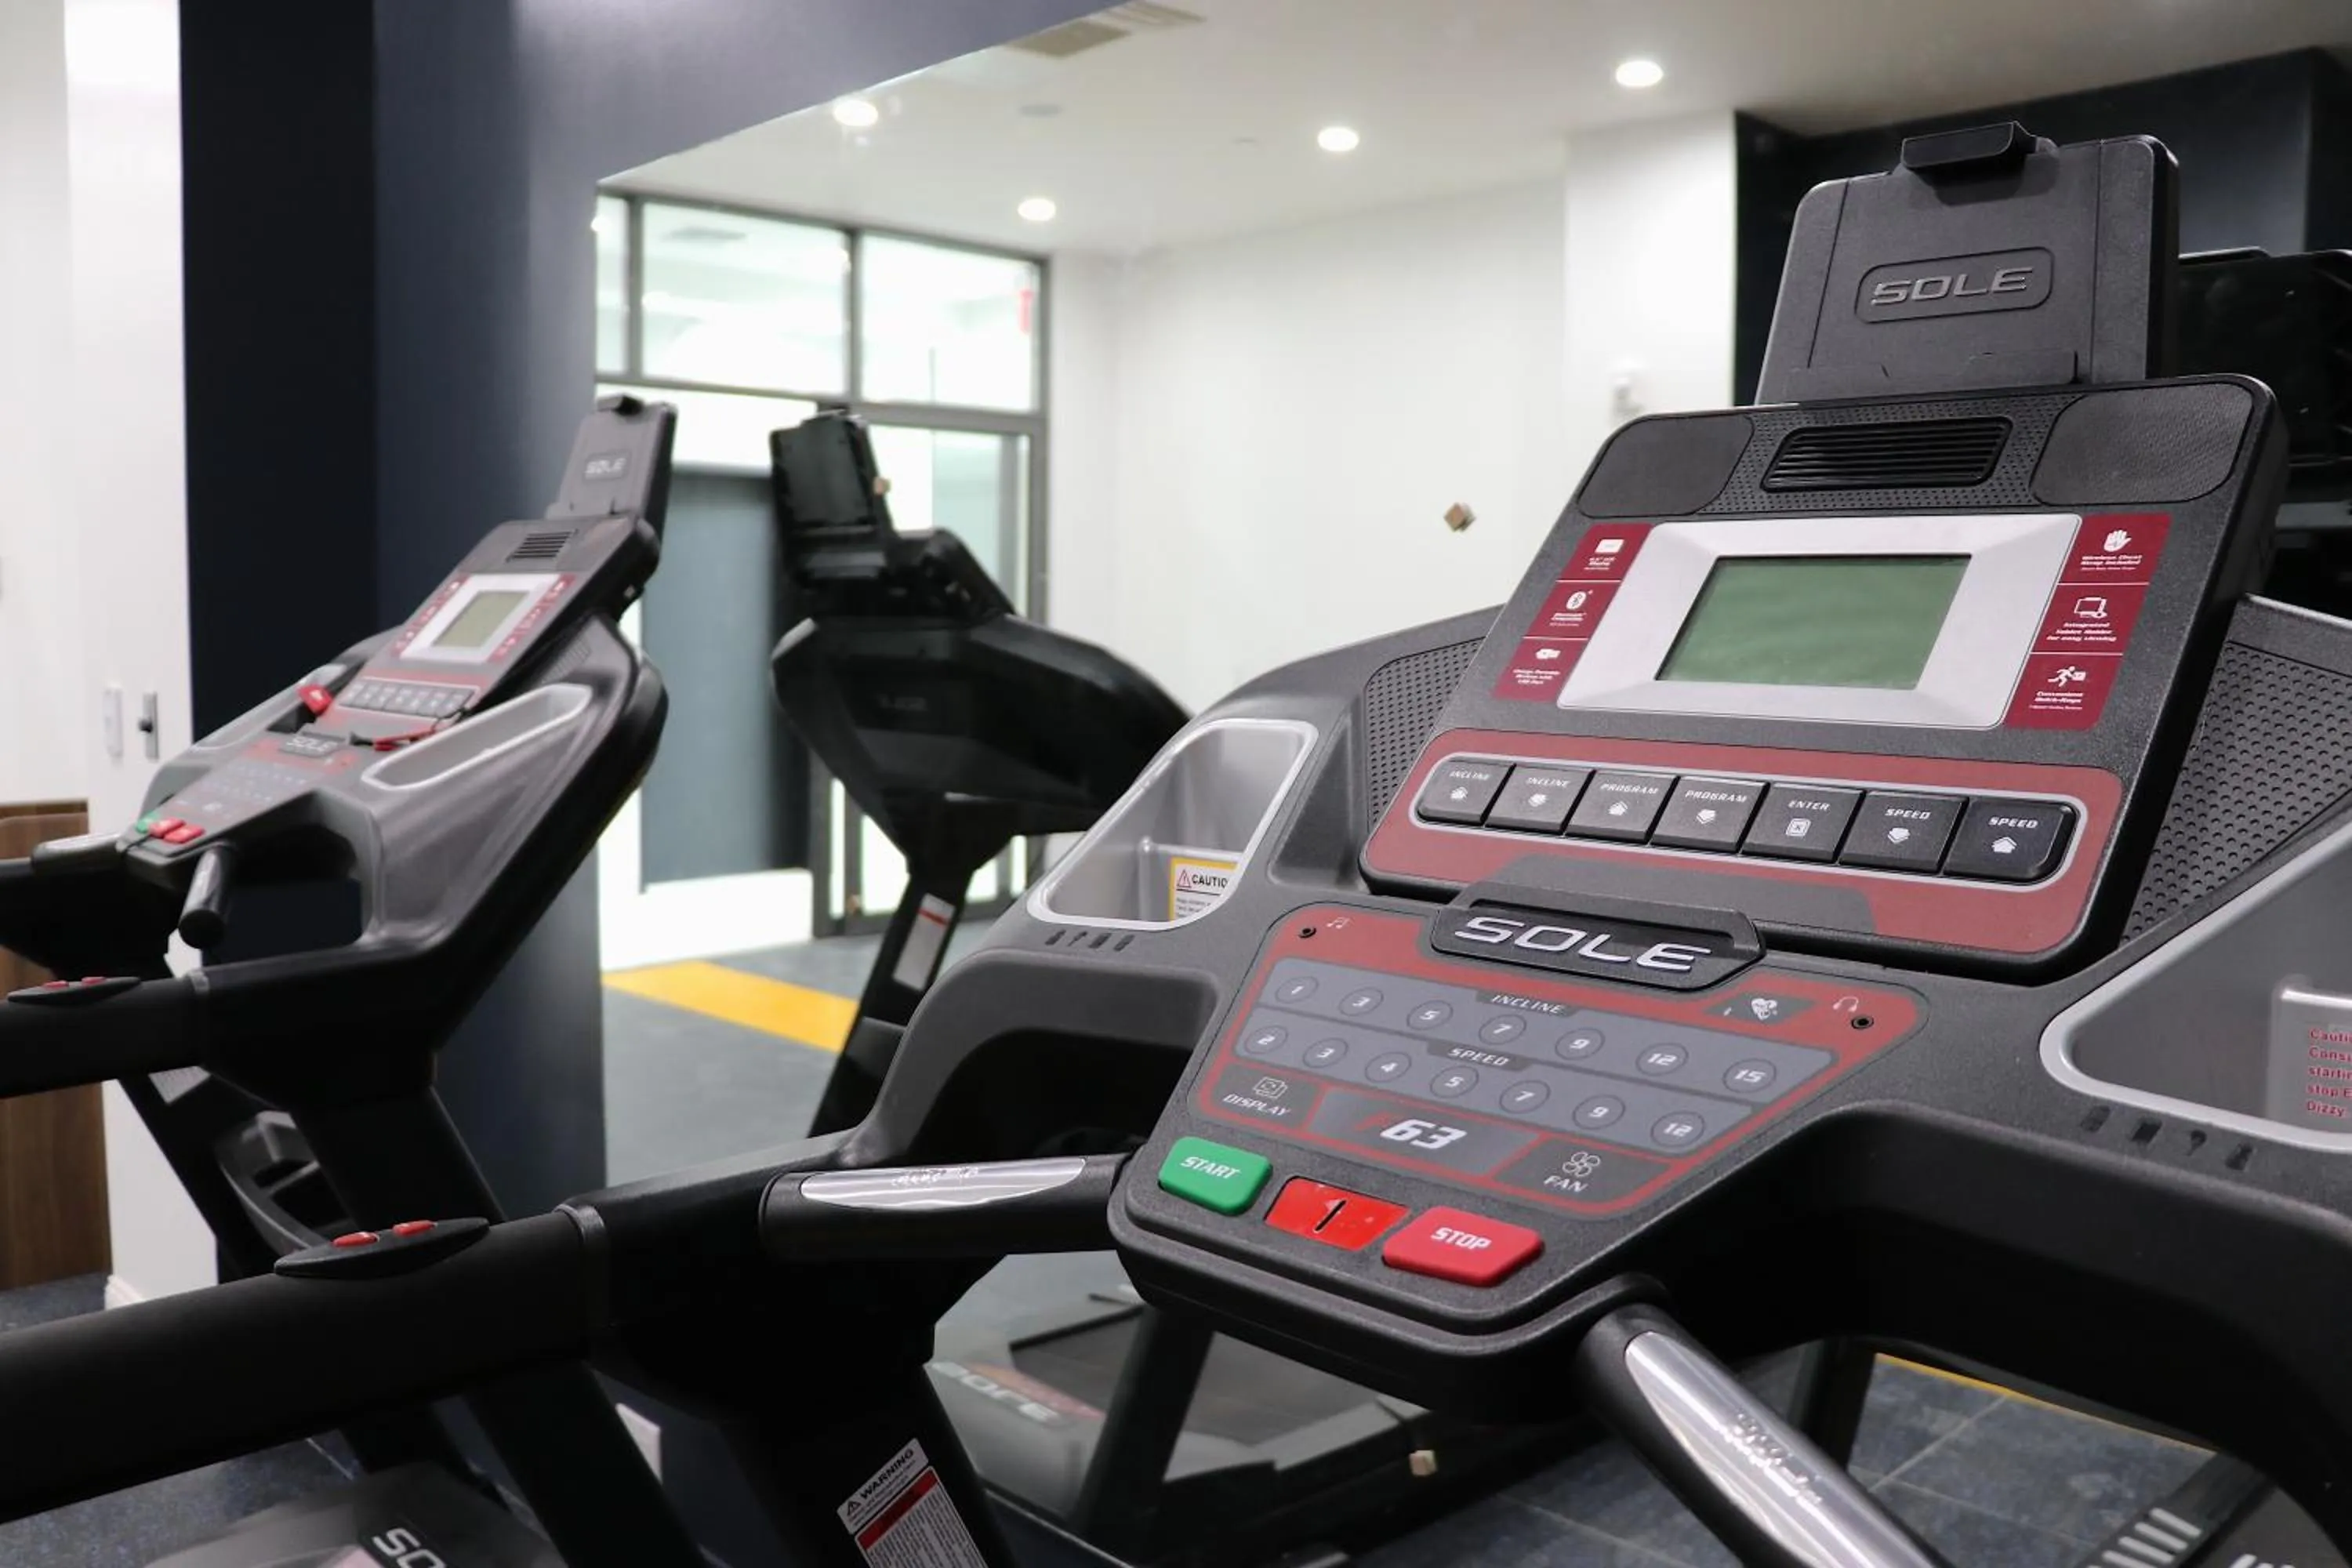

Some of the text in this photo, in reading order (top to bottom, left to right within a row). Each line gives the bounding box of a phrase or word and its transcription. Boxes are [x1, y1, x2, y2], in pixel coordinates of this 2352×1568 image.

[1871, 267, 2033, 306] SOLE
[1526, 776, 1571, 788] INCLINE
[1600, 782, 1659, 795] PROGRAM
[1685, 790, 1748, 803] PROGRAM
[1788, 800, 1831, 811] ENTER
[1885, 808, 1930, 820] SPEED
[1988, 816, 2038, 829] SPEED
[1454, 916, 1711, 973] SOLE
[1291, 985, 1304, 996] 1
[1352, 996, 1370, 1007] 3
[1492, 993, 1566, 1014] INCLINE
[1419, 1008, 1440, 1021] 5
[1493, 1023, 1512, 1035] 7
[1257, 1034, 1275, 1046] 2
[1570, 1037, 1590, 1051] 9
[1316, 1047, 1335, 1059] 3
[1448, 1047, 1509, 1066] SPEED
[1647, 1052, 1678, 1066] 12
[1381, 1062, 1398, 1074] 4
[1445, 1076, 1465, 1088] 5
[1734, 1069, 1766, 1083] 15
[1515, 1091, 1534, 1102] 7
[1223, 1094, 1290, 1117] DISPLAY
[1588, 1105, 1609, 1119] 9
[2307, 1101, 2345, 1117] Dizzy
[1379, 1119, 1467, 1150] 63
[1663, 1122, 1693, 1138] 12
[1179, 1156, 1240, 1179] START
[1544, 1175, 1588, 1192] FAN
[1430, 1227, 1492, 1250] STOP
